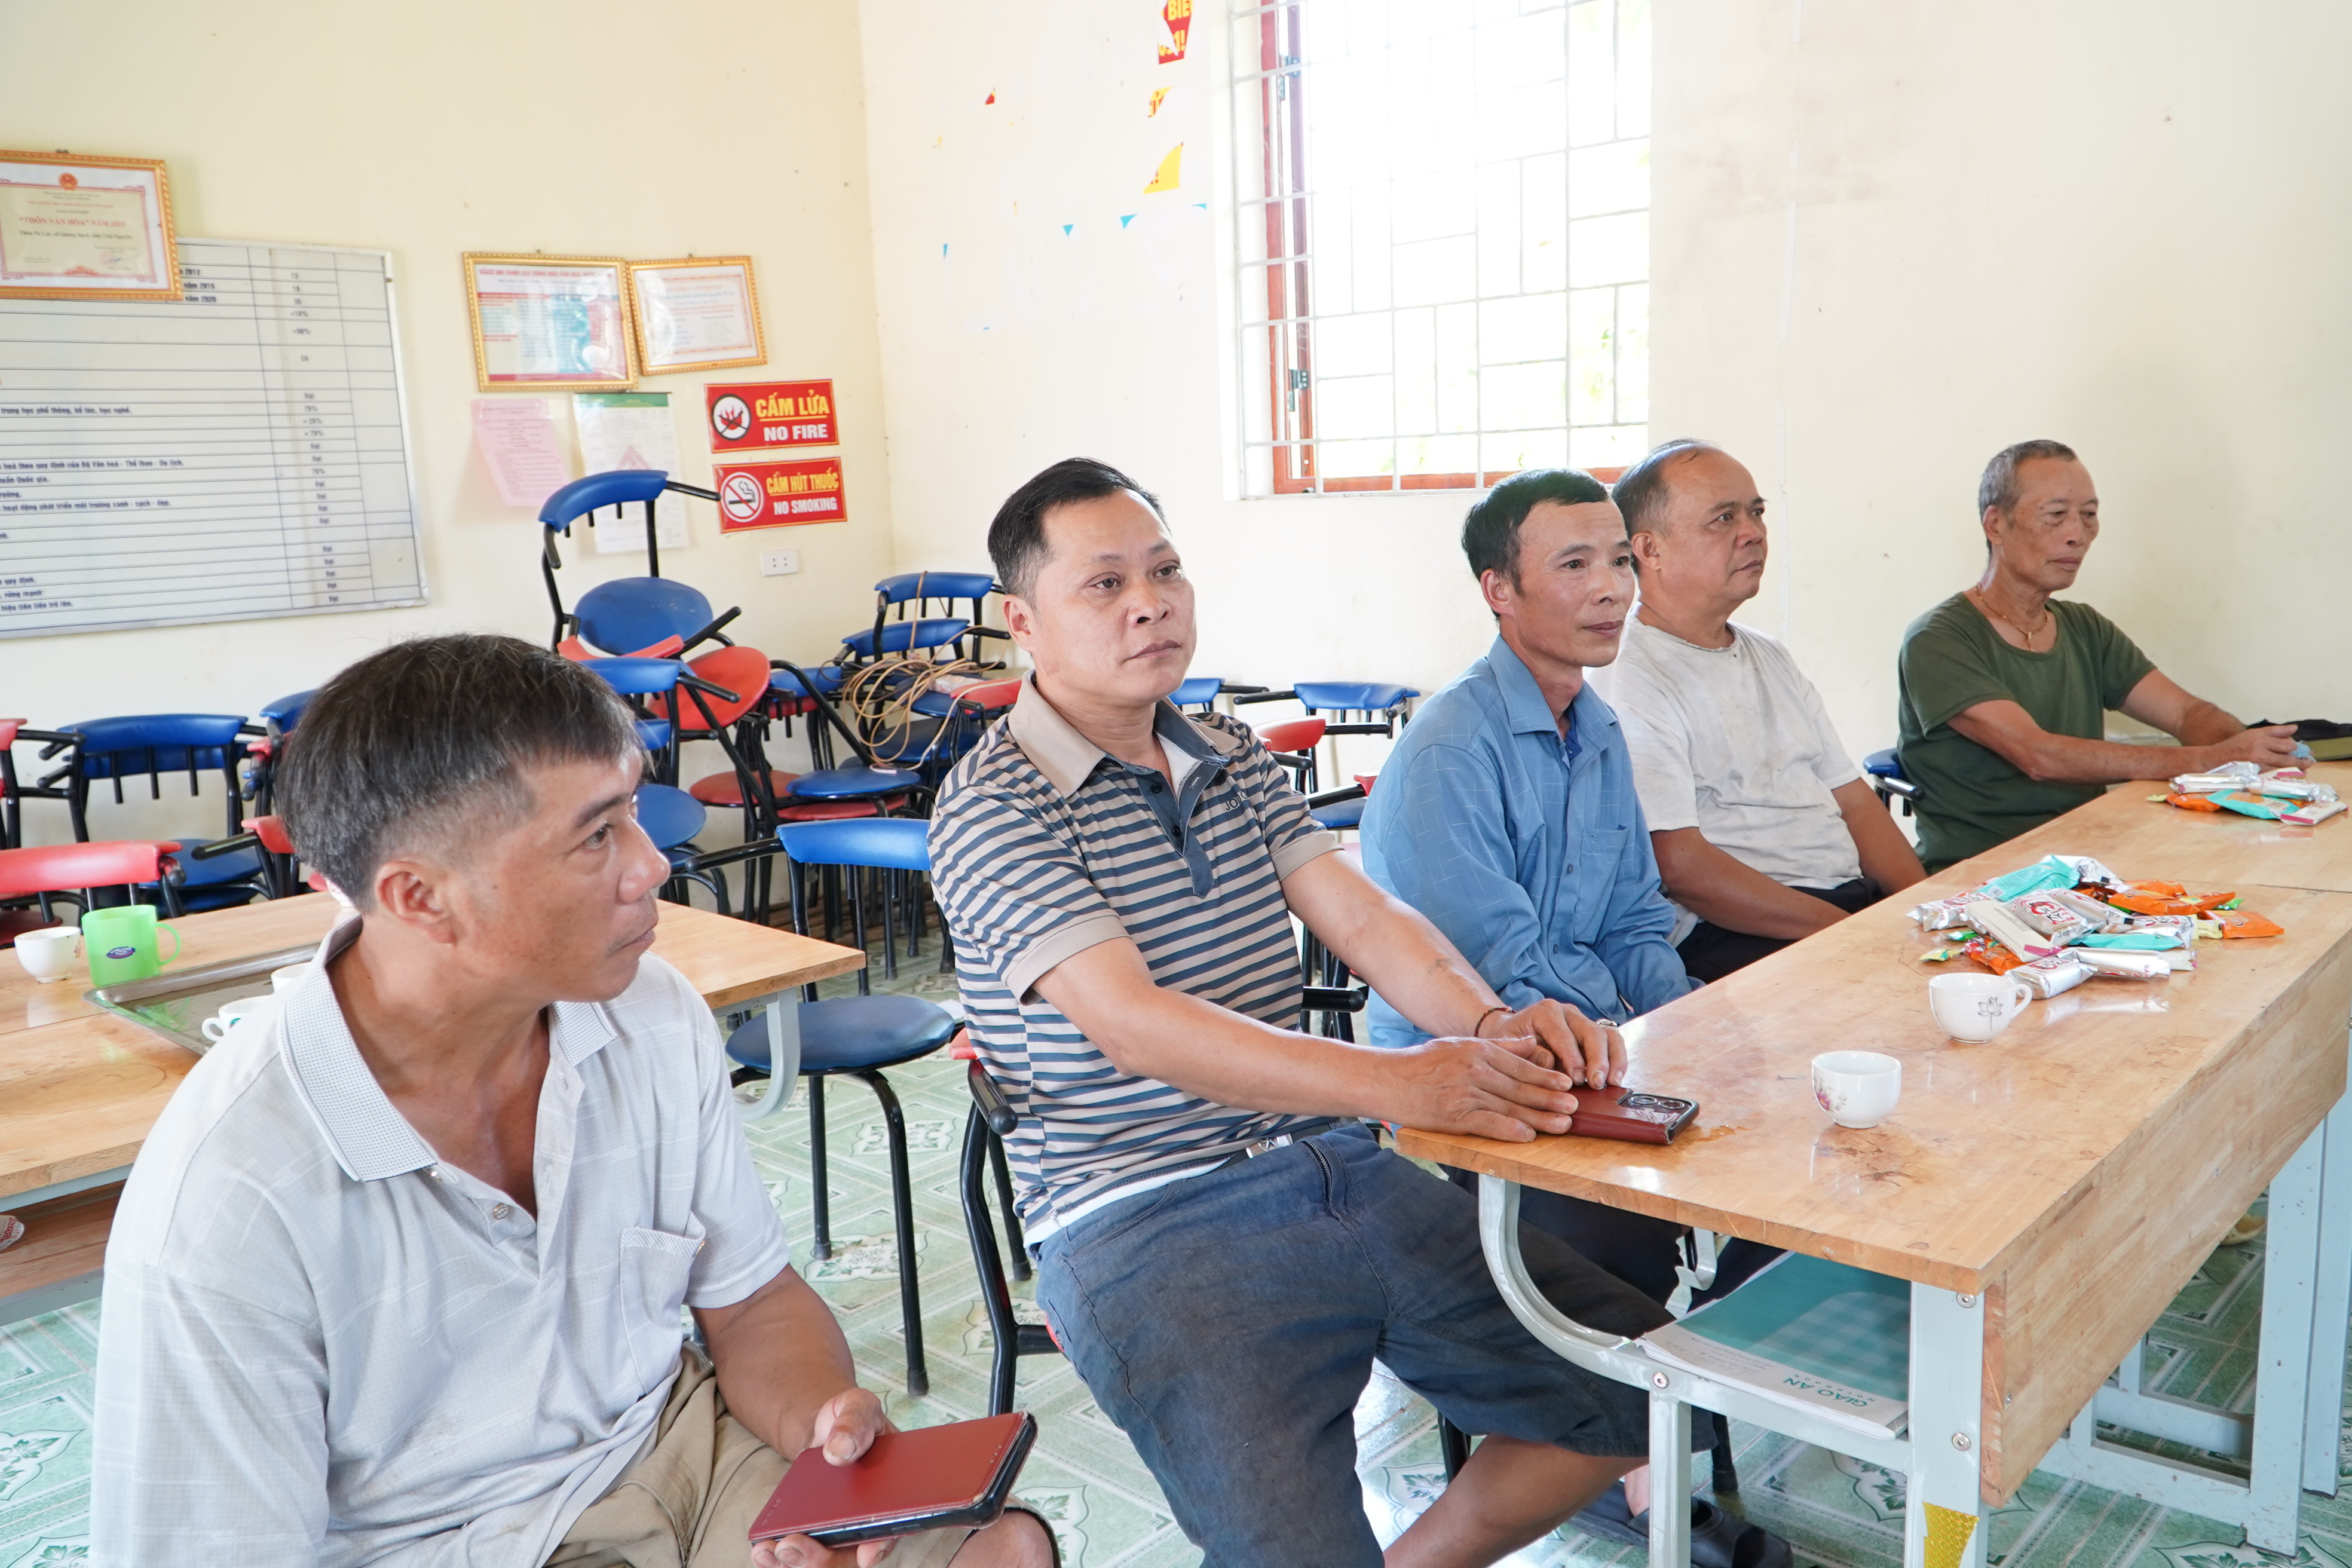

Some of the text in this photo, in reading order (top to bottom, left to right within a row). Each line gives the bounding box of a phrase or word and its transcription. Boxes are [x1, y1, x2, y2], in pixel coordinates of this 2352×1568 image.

[21, 406, 34, 415] học
[36, 406, 49, 415] phổ
[99, 406, 112, 416] học
[755, 389, 830, 418] CẤM LỬA
[763, 424, 828, 442] NO FIRE
[766, 467, 840, 494] CẤM HÚT THUỐC
[773, 497, 838, 516] NO SMOKING
[1783, 1377, 1868, 1407] GIÁO ÁN
